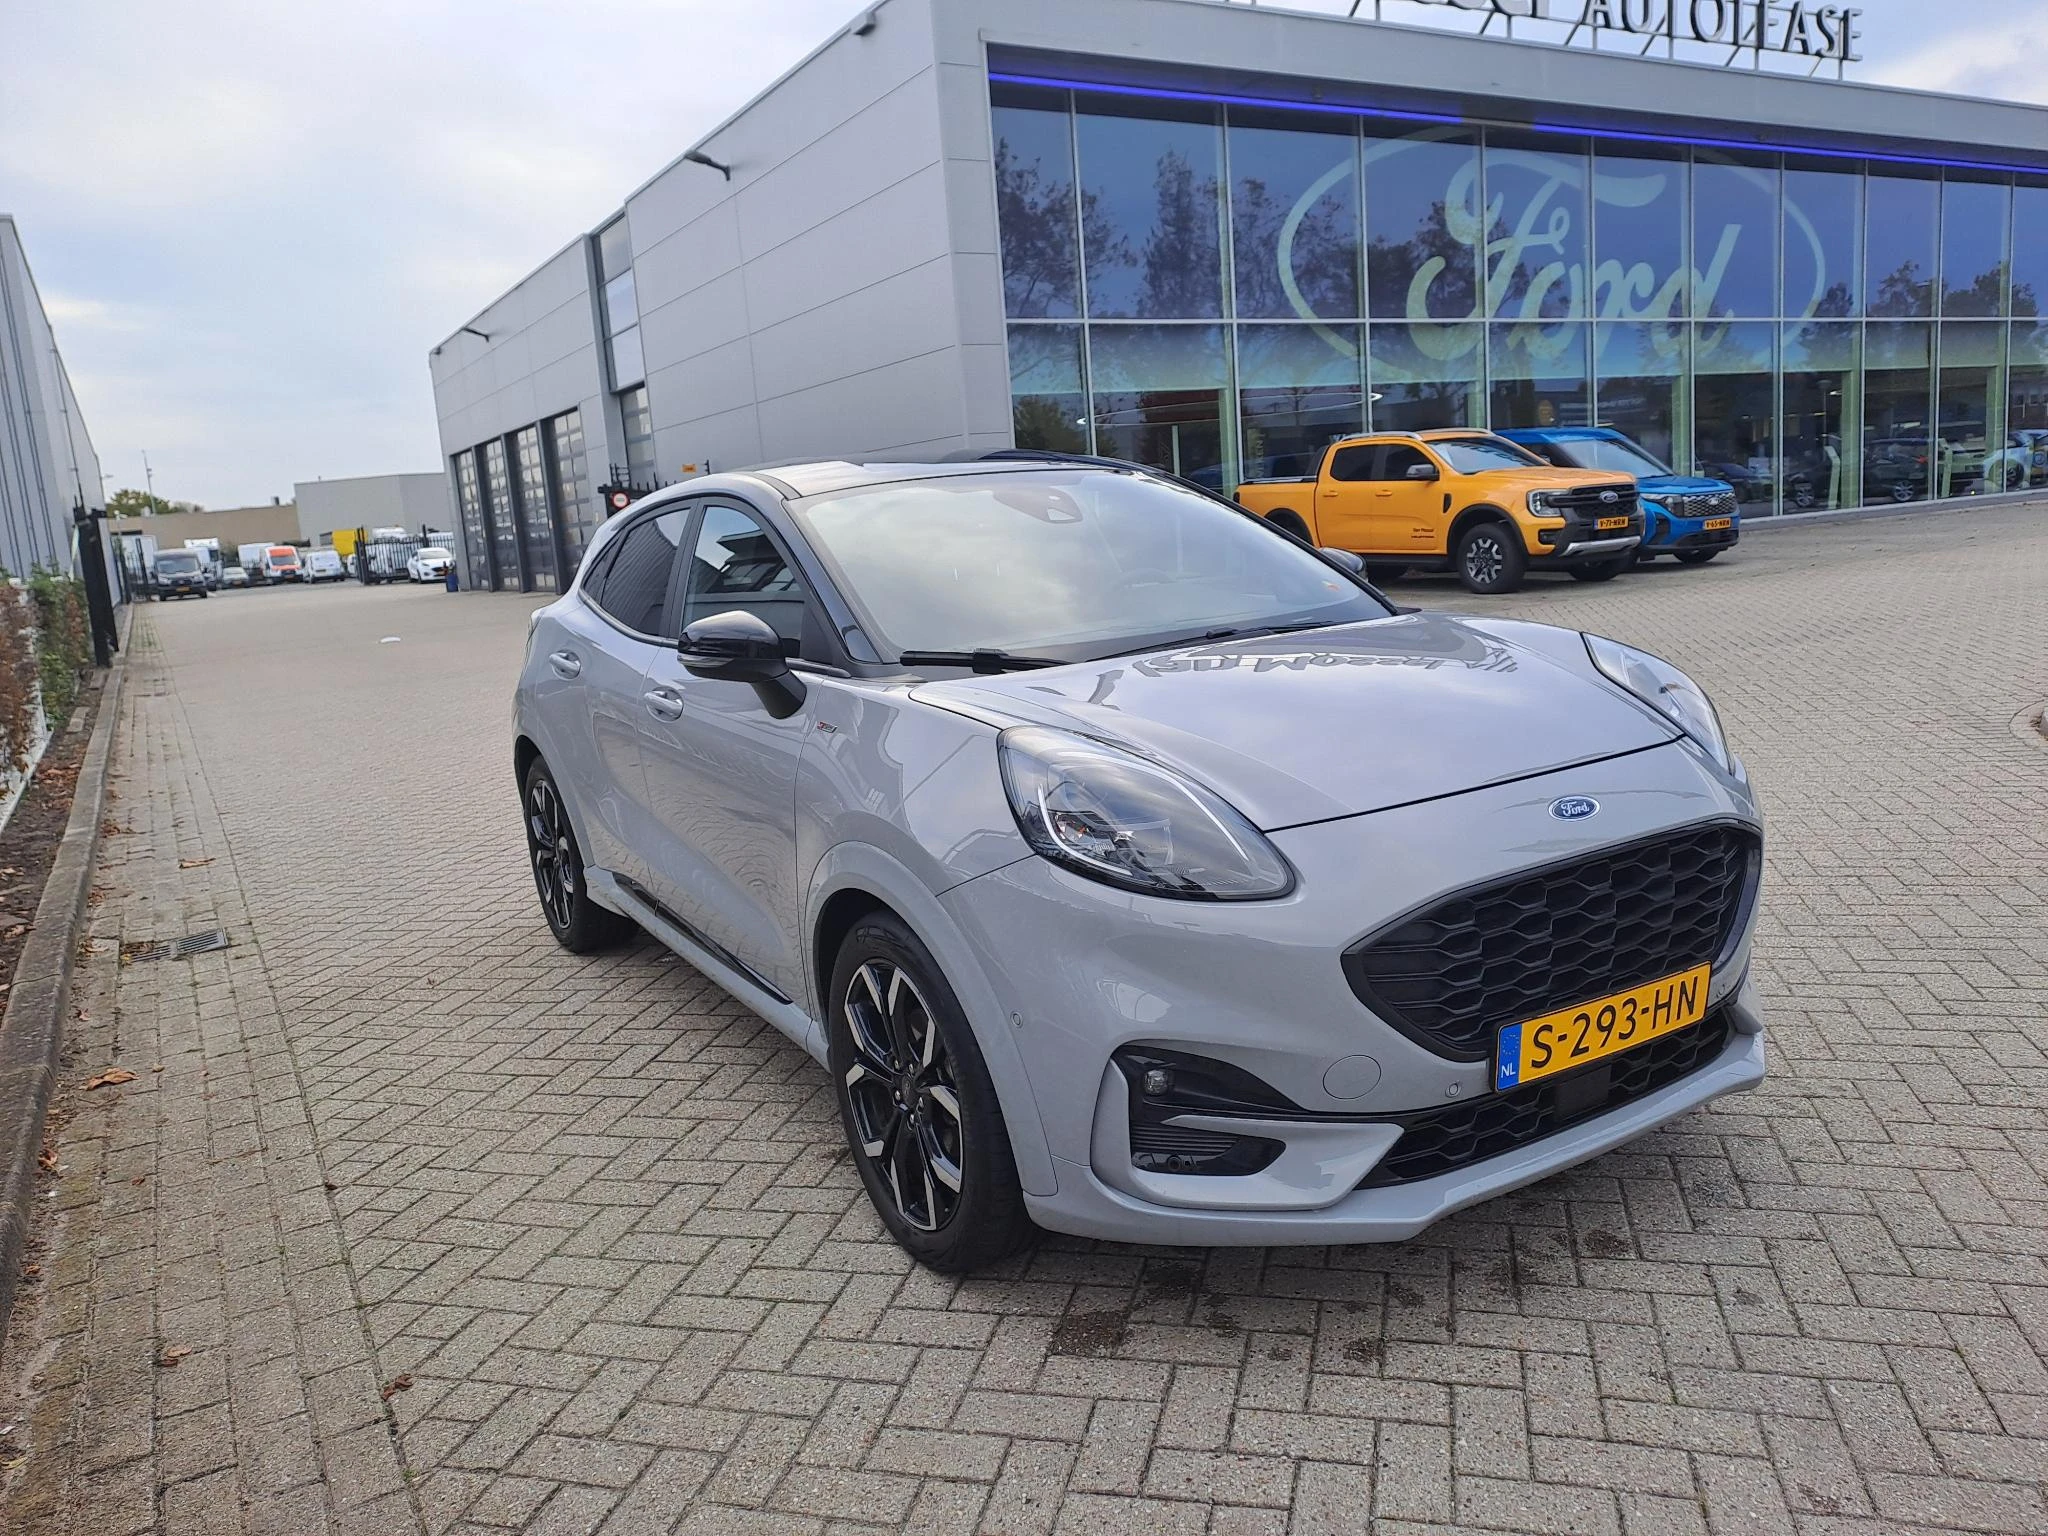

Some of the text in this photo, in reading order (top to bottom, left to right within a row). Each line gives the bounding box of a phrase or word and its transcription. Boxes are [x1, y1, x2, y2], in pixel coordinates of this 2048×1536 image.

[1405, 146, 1743, 362] Ford
[1560, 800, 1590, 817] Ford
[1530, 975, 1699, 1069] S-293-HN
[1500, 1062, 1517, 1079] NL
